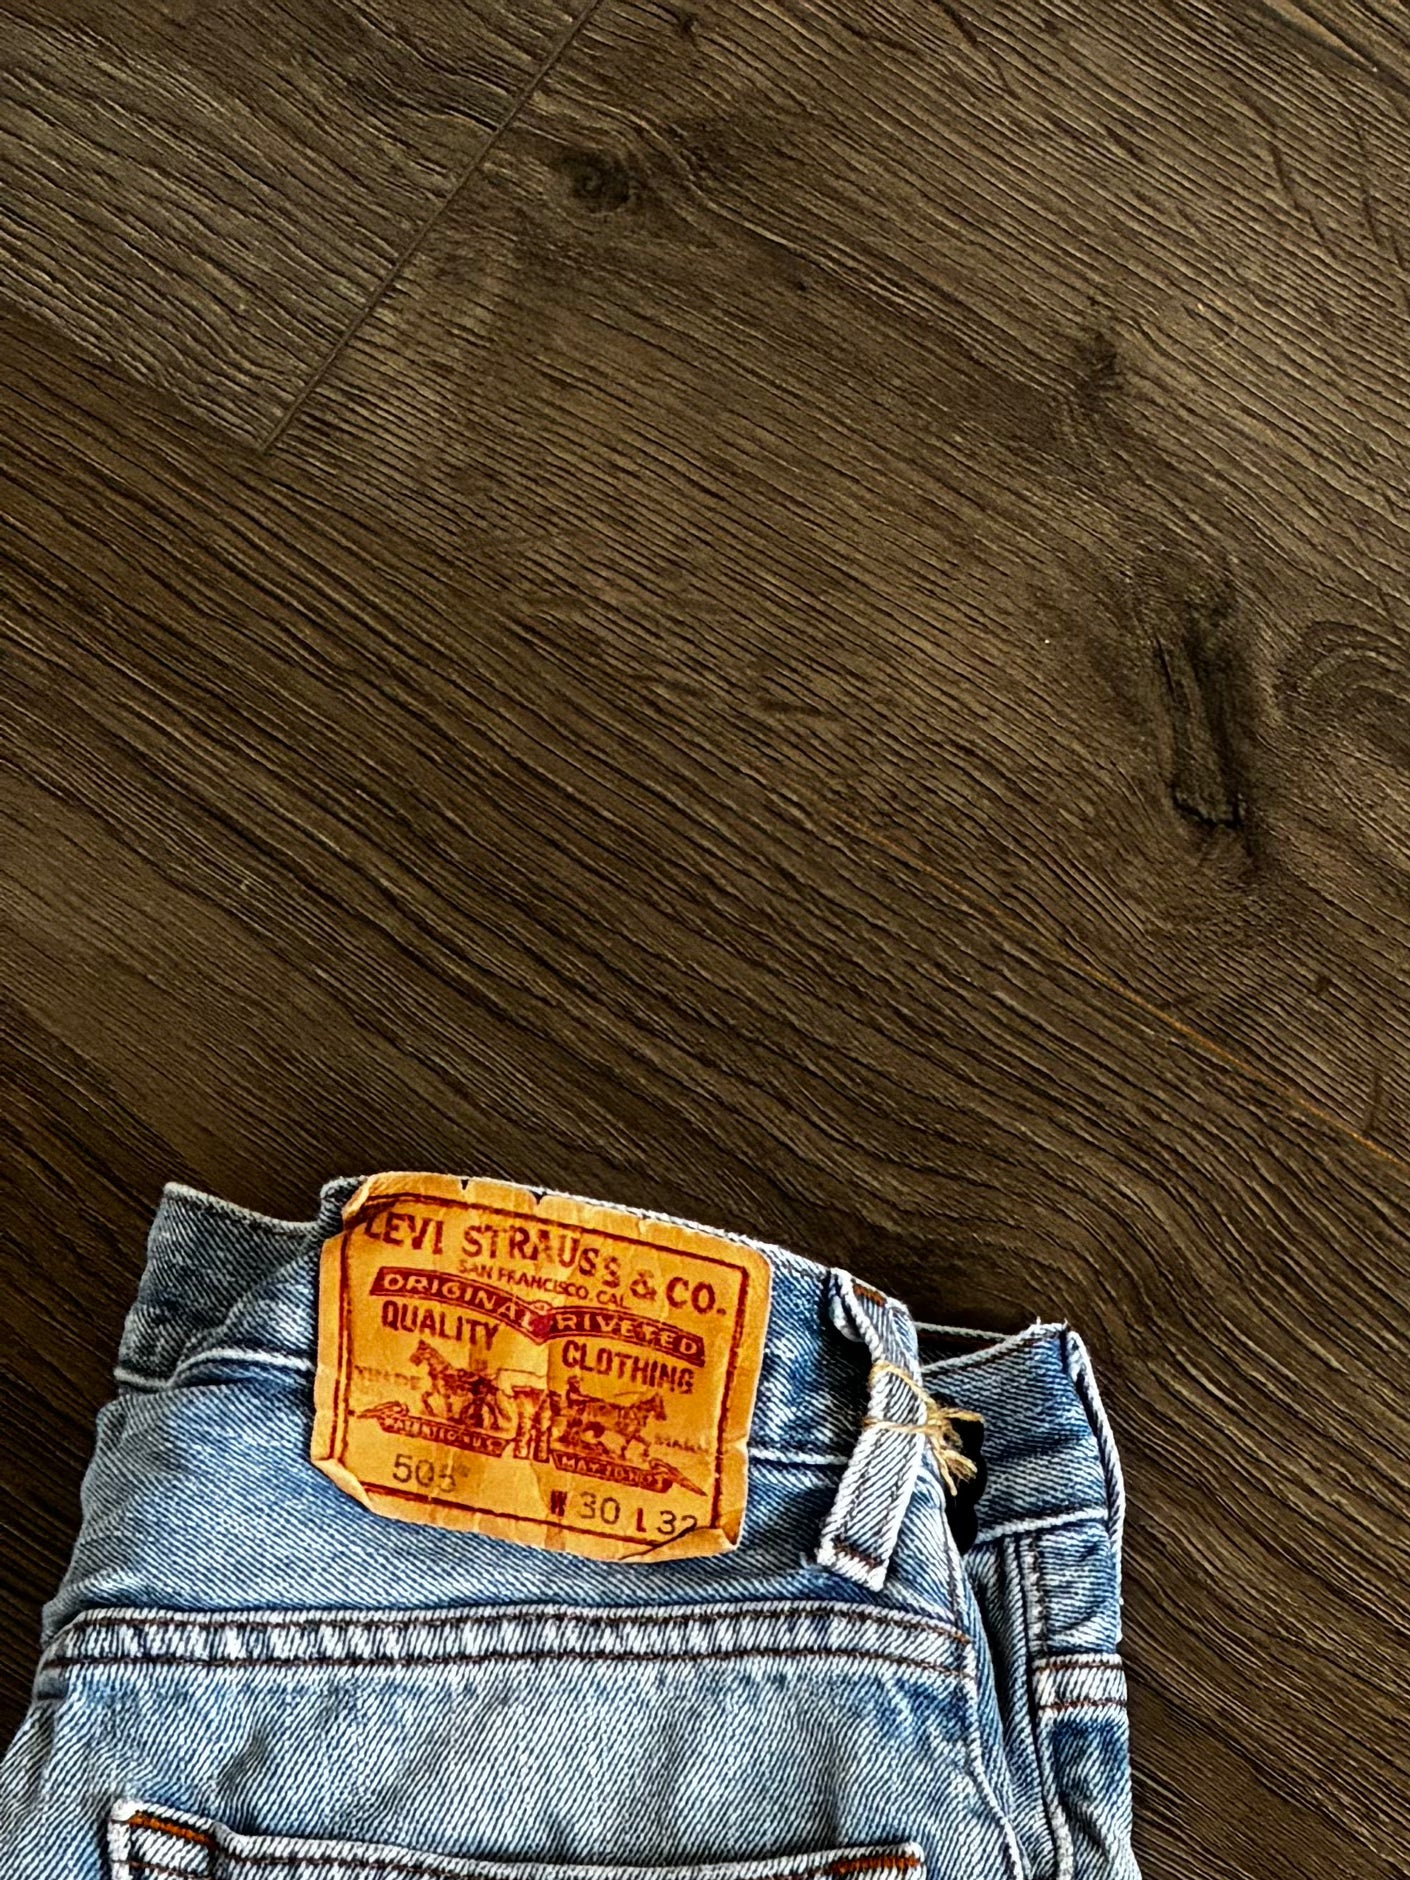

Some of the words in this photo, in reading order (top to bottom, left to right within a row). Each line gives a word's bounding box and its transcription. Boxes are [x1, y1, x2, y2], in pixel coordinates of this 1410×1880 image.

[364, 1211, 443, 1255] LEVI
[461, 1224, 621, 1288] STRAUSS
[630, 1269, 657, 1301] &
[666, 1276, 727, 1315] CO.
[458, 1259, 493, 1281] SAN
[381, 1300, 499, 1351] QUALITY
[383, 1273, 534, 1331] ORIGINAL
[555, 1313, 698, 1355] RIVETED
[562, 1339, 695, 1394] CLOTHING
[579, 1490, 621, 1525] 30
[635, 1507, 647, 1533] L
